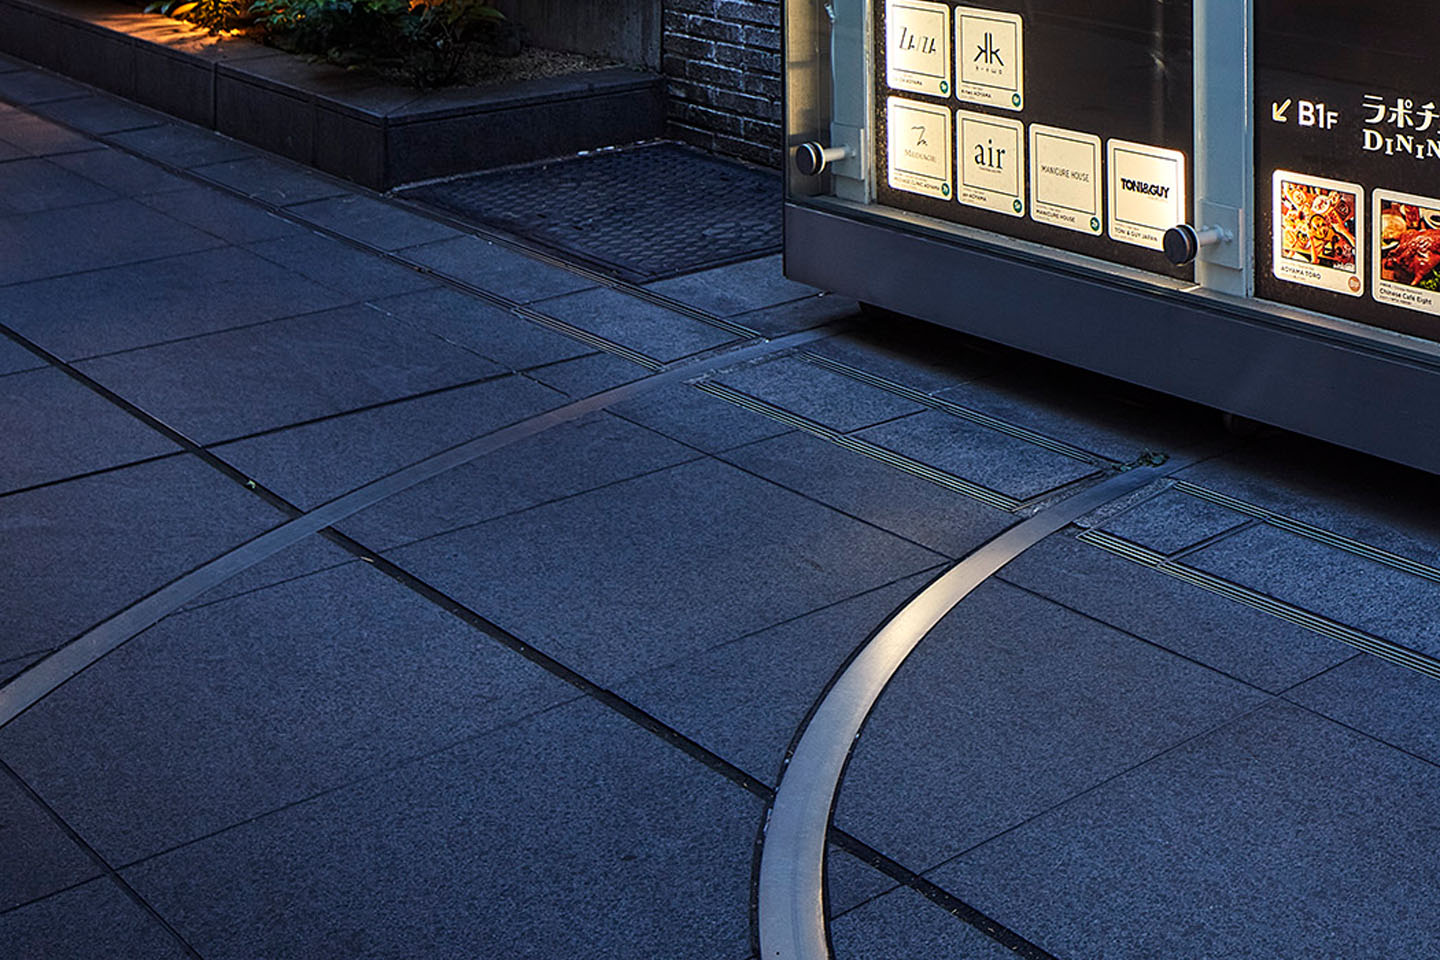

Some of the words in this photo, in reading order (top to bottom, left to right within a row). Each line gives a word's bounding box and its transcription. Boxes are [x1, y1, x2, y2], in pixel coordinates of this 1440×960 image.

[1297, 99, 1340, 130] B1F
[974, 138, 1006, 170] air
[1120, 177, 1170, 199] TONI&GUY
